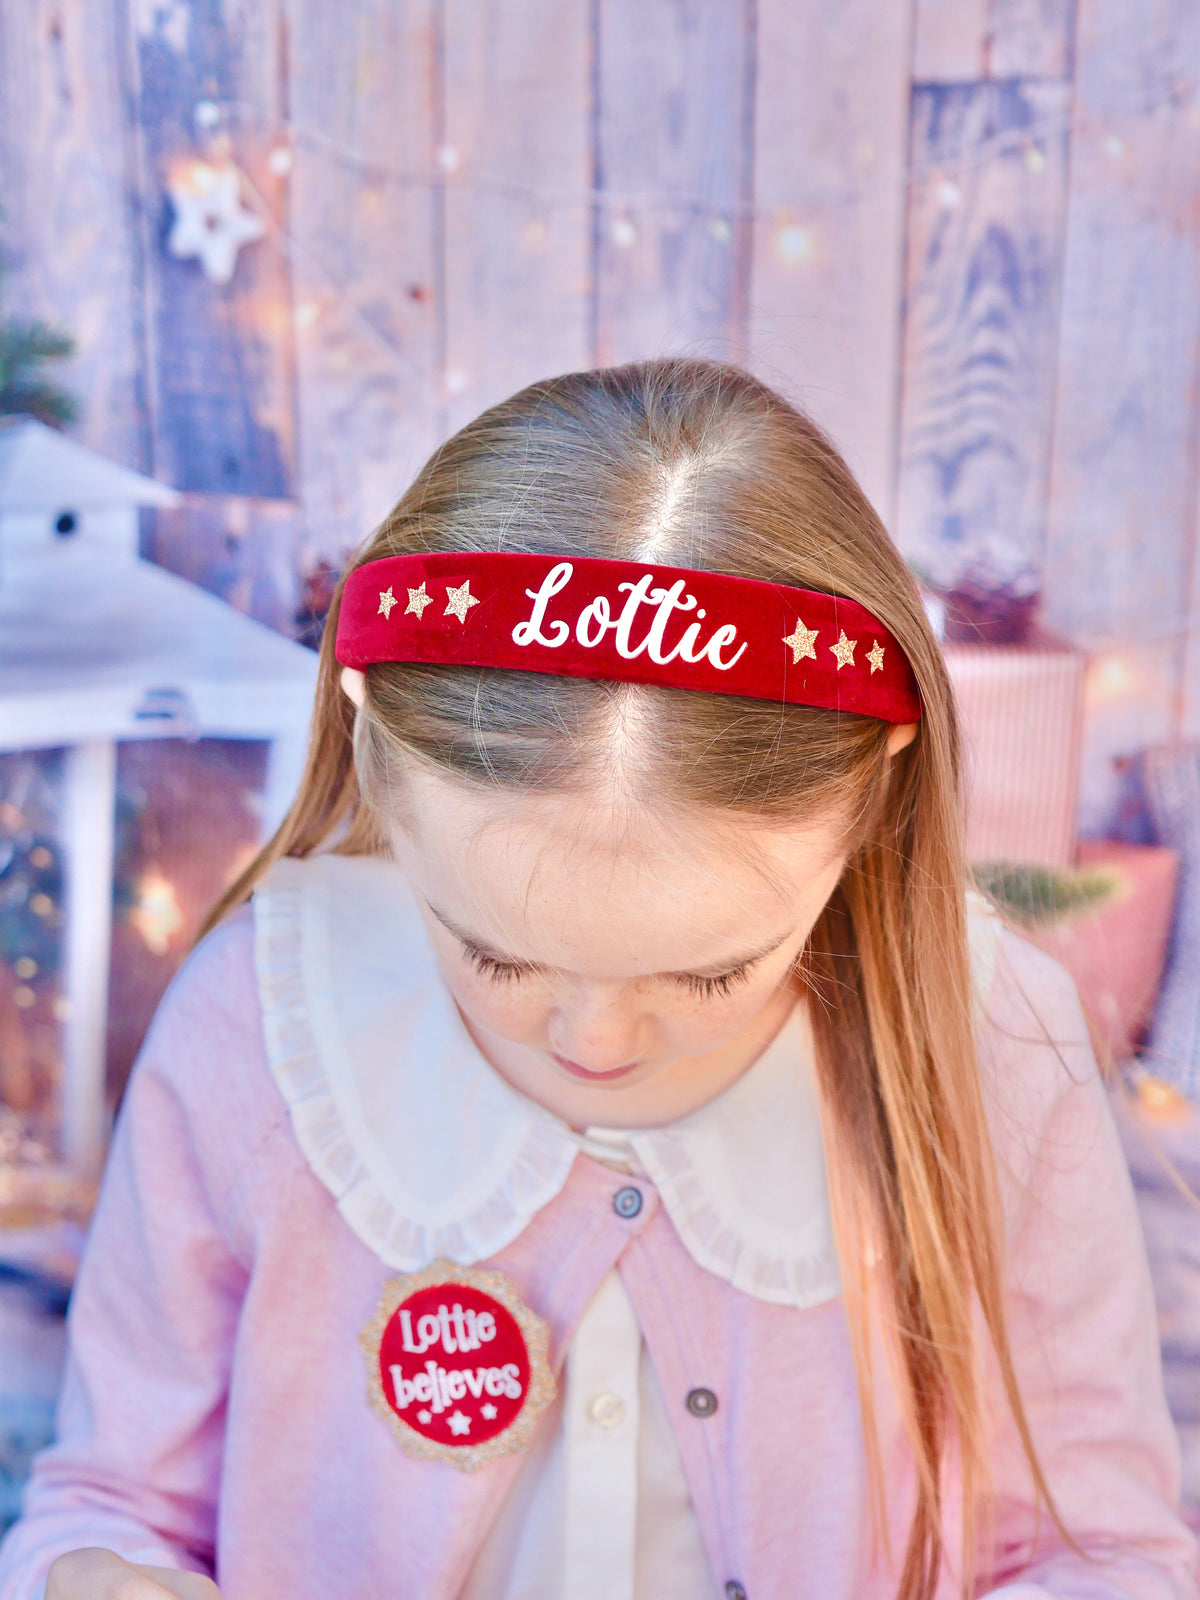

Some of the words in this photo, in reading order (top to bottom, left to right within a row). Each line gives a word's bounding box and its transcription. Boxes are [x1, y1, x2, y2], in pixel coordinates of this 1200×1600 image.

[511, 562, 748, 671] Lottie
[400, 1303, 496, 1354] Lottie
[389, 1360, 522, 1413] believes
